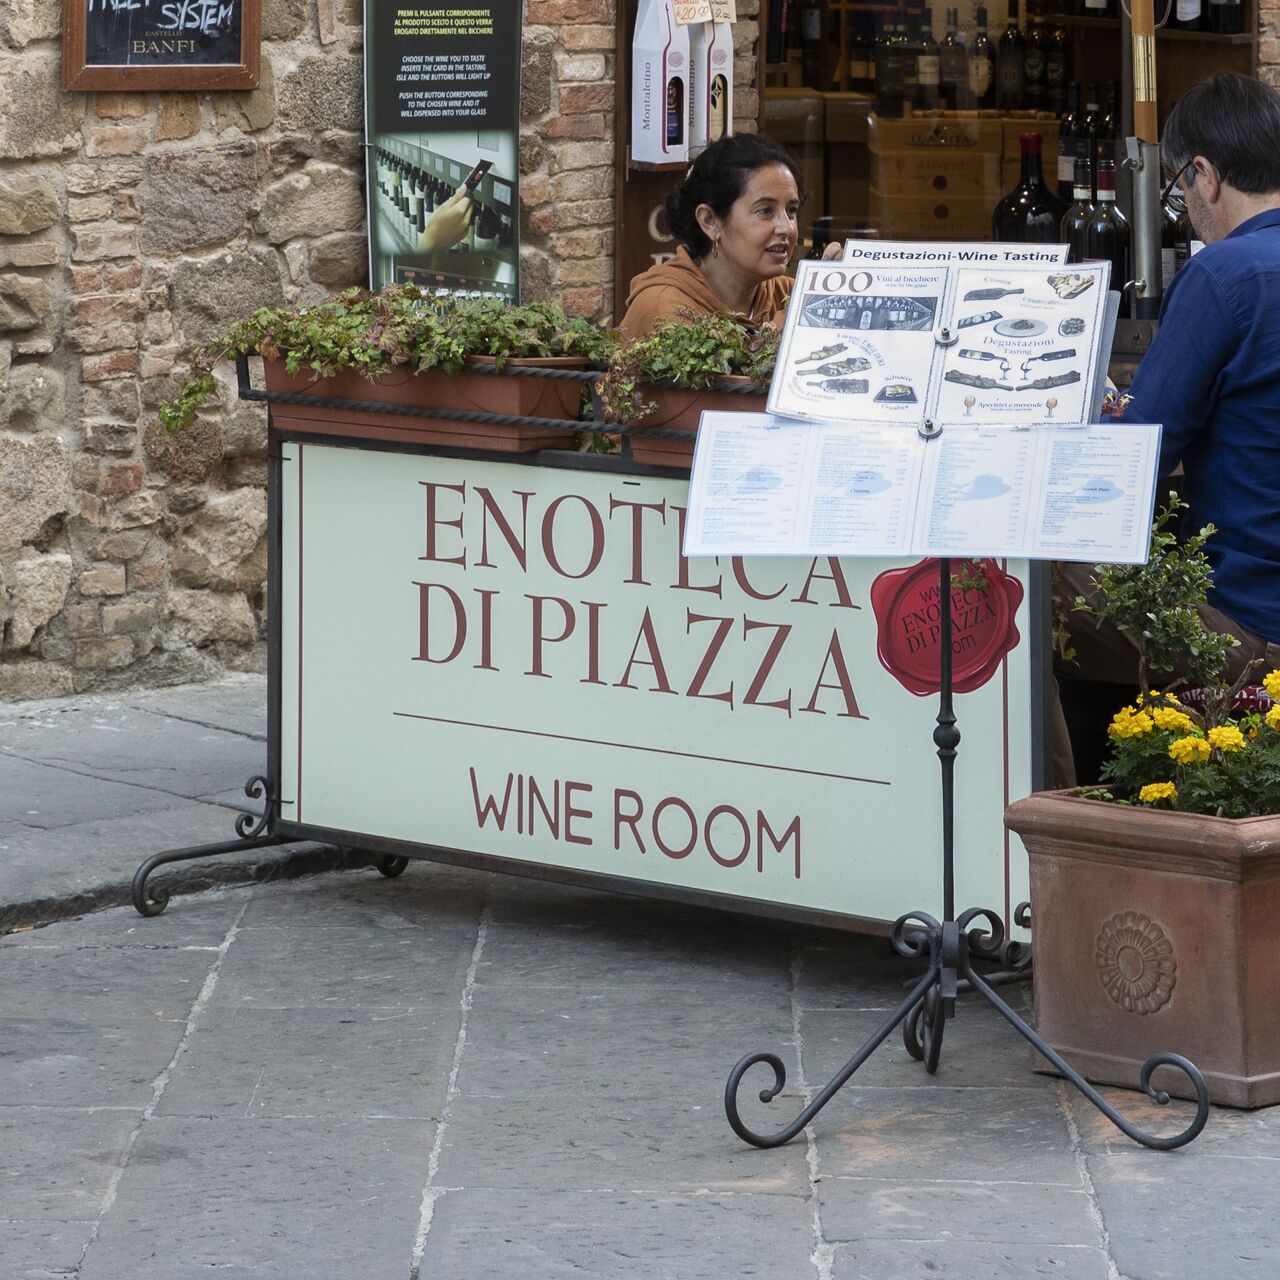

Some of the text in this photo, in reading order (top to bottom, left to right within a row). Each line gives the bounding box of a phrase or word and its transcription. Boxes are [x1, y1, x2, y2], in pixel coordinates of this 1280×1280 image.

[157, 0, 234, 36] SYSTEM
[133, 40, 196, 54] BANFI
[642, 62, 652, 131] Montalcino
[1003, 251, 1060, 263] Tasting
[808, 271, 874, 293] 100
[983, 336, 1056, 347] Degustazioni
[412, 581, 870, 720] DI PIAZZA
[469, 765, 802, 878] WINE ROOM
